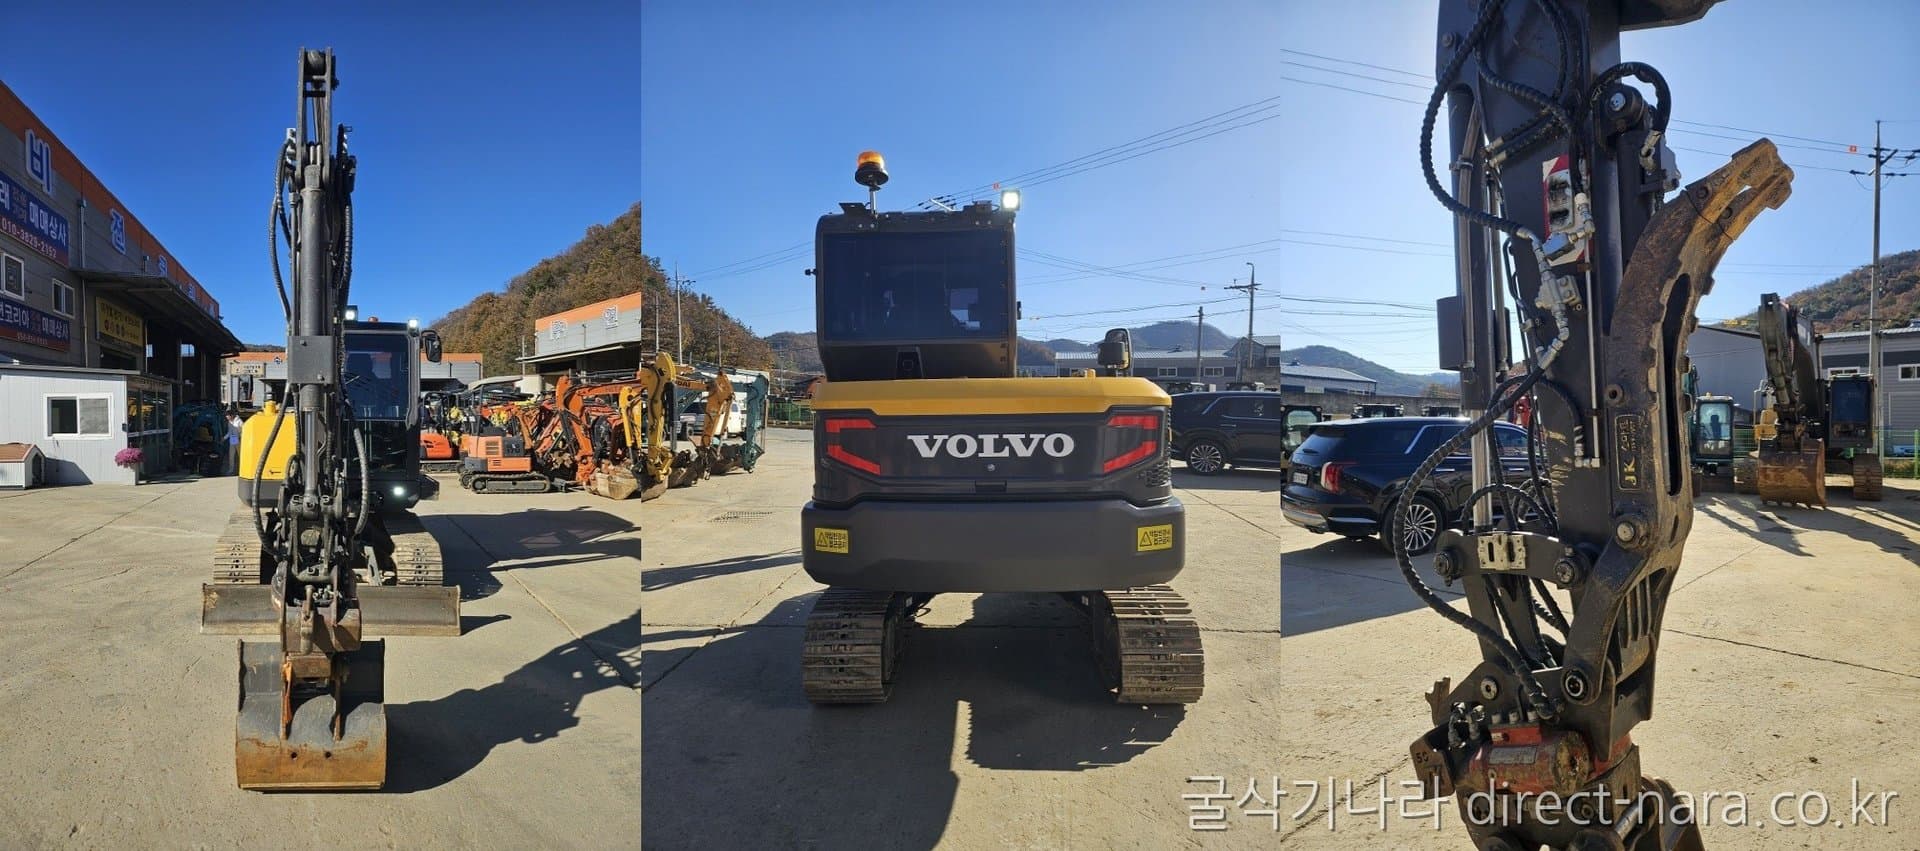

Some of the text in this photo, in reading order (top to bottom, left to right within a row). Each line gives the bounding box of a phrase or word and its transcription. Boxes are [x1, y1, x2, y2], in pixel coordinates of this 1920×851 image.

[25, 128, 53, 197] 비
[29, 201, 67, 247] 매매상사
[907, 433, 1075, 459] VOLVO
[1623, 455, 1638, 487] JK
